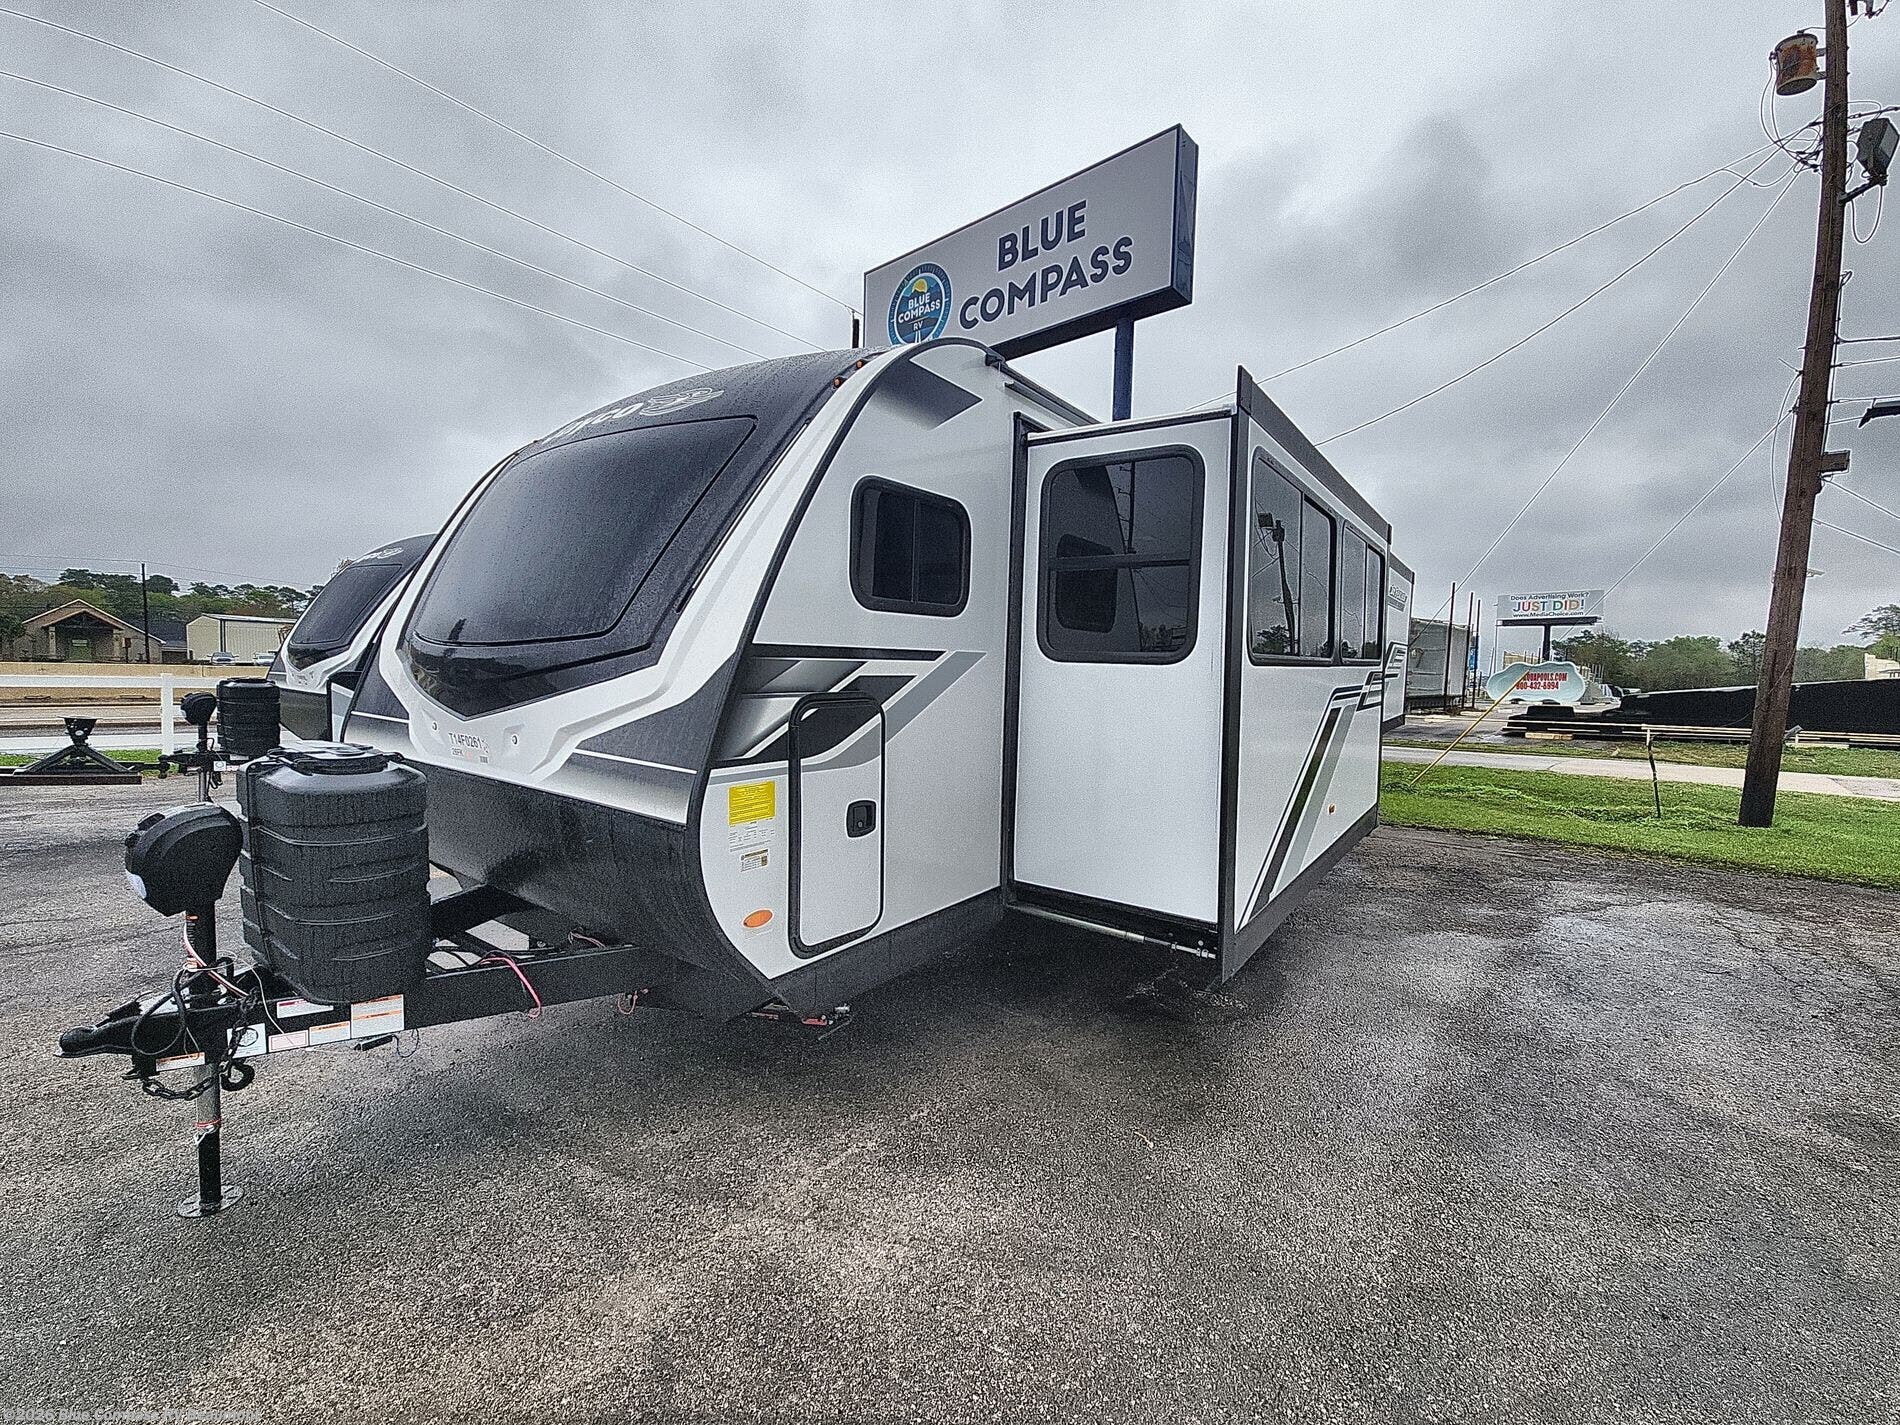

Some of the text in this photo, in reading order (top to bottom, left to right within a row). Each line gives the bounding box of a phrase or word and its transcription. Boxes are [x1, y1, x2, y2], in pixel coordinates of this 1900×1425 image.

[998, 200, 1087, 272] BLUE
[959, 236, 1133, 330] COMPASS
[898, 299, 941, 323] COMPASS
[908, 292, 931, 310] BLUE
[913, 321, 924, 331] RV
[1513, 599, 1585, 612] JUST DID!
